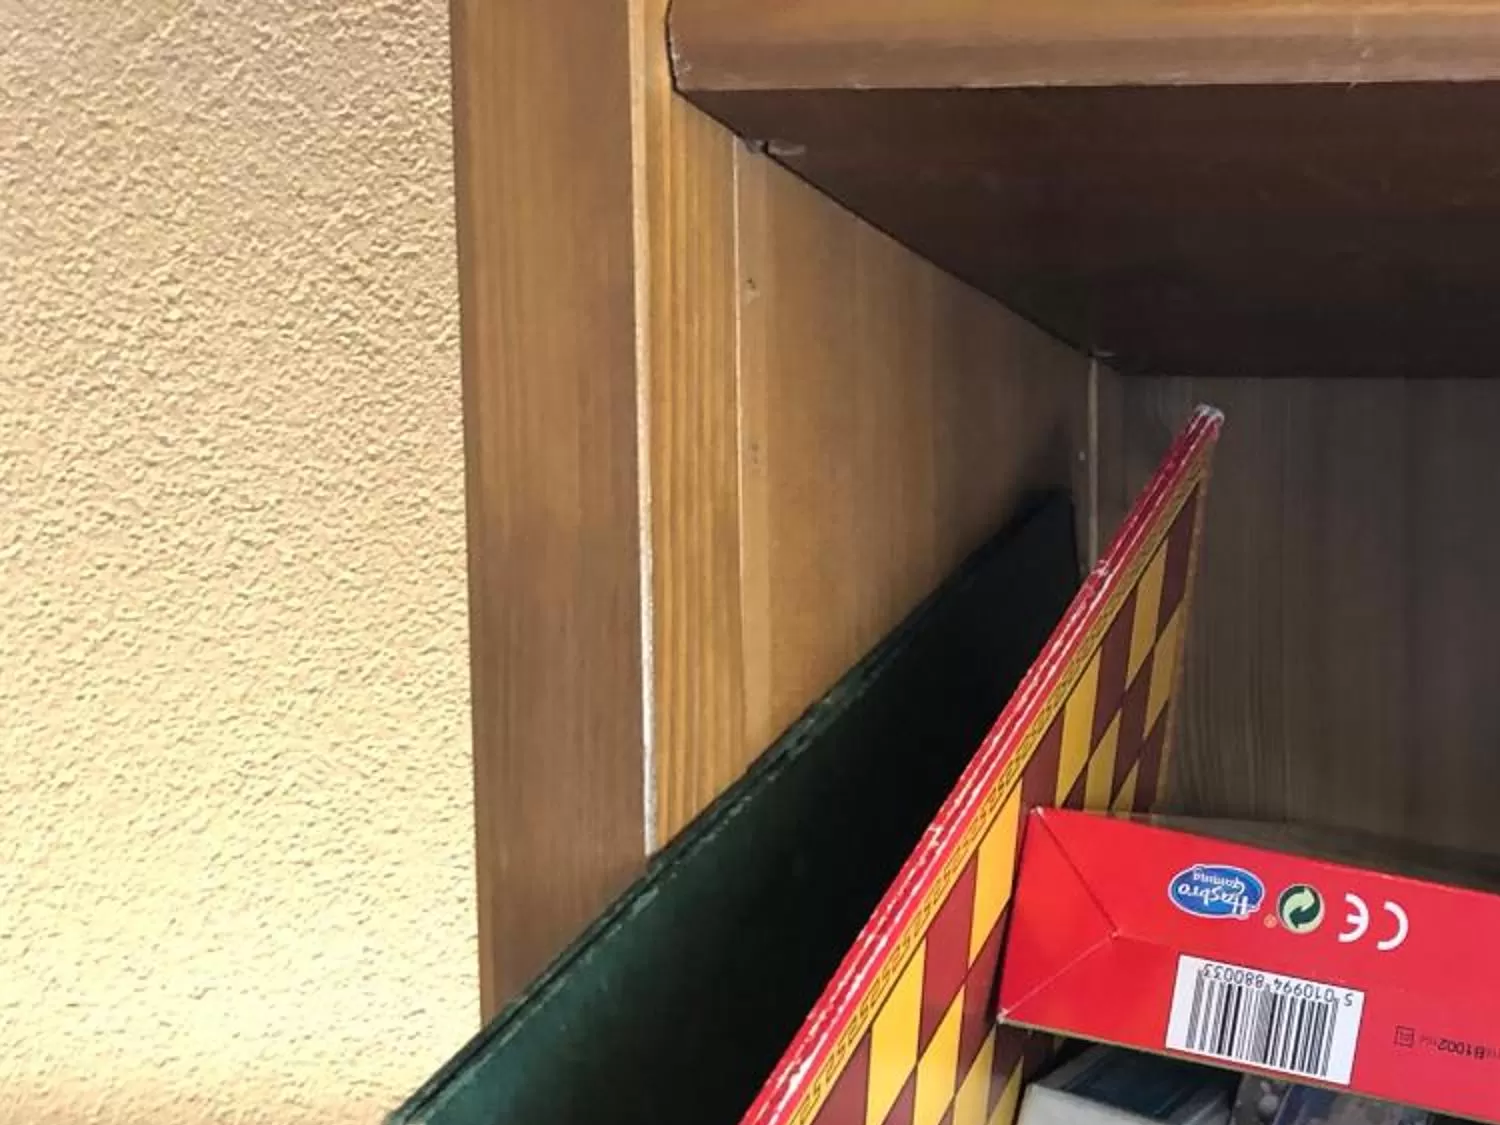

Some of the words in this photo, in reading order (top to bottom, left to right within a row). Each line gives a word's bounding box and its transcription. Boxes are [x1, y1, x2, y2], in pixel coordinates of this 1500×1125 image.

[1178, 883, 1252, 915] Hasbro
[1203, 964, 1265, 989] 880033
[1273, 978, 1336, 1003] 010994
